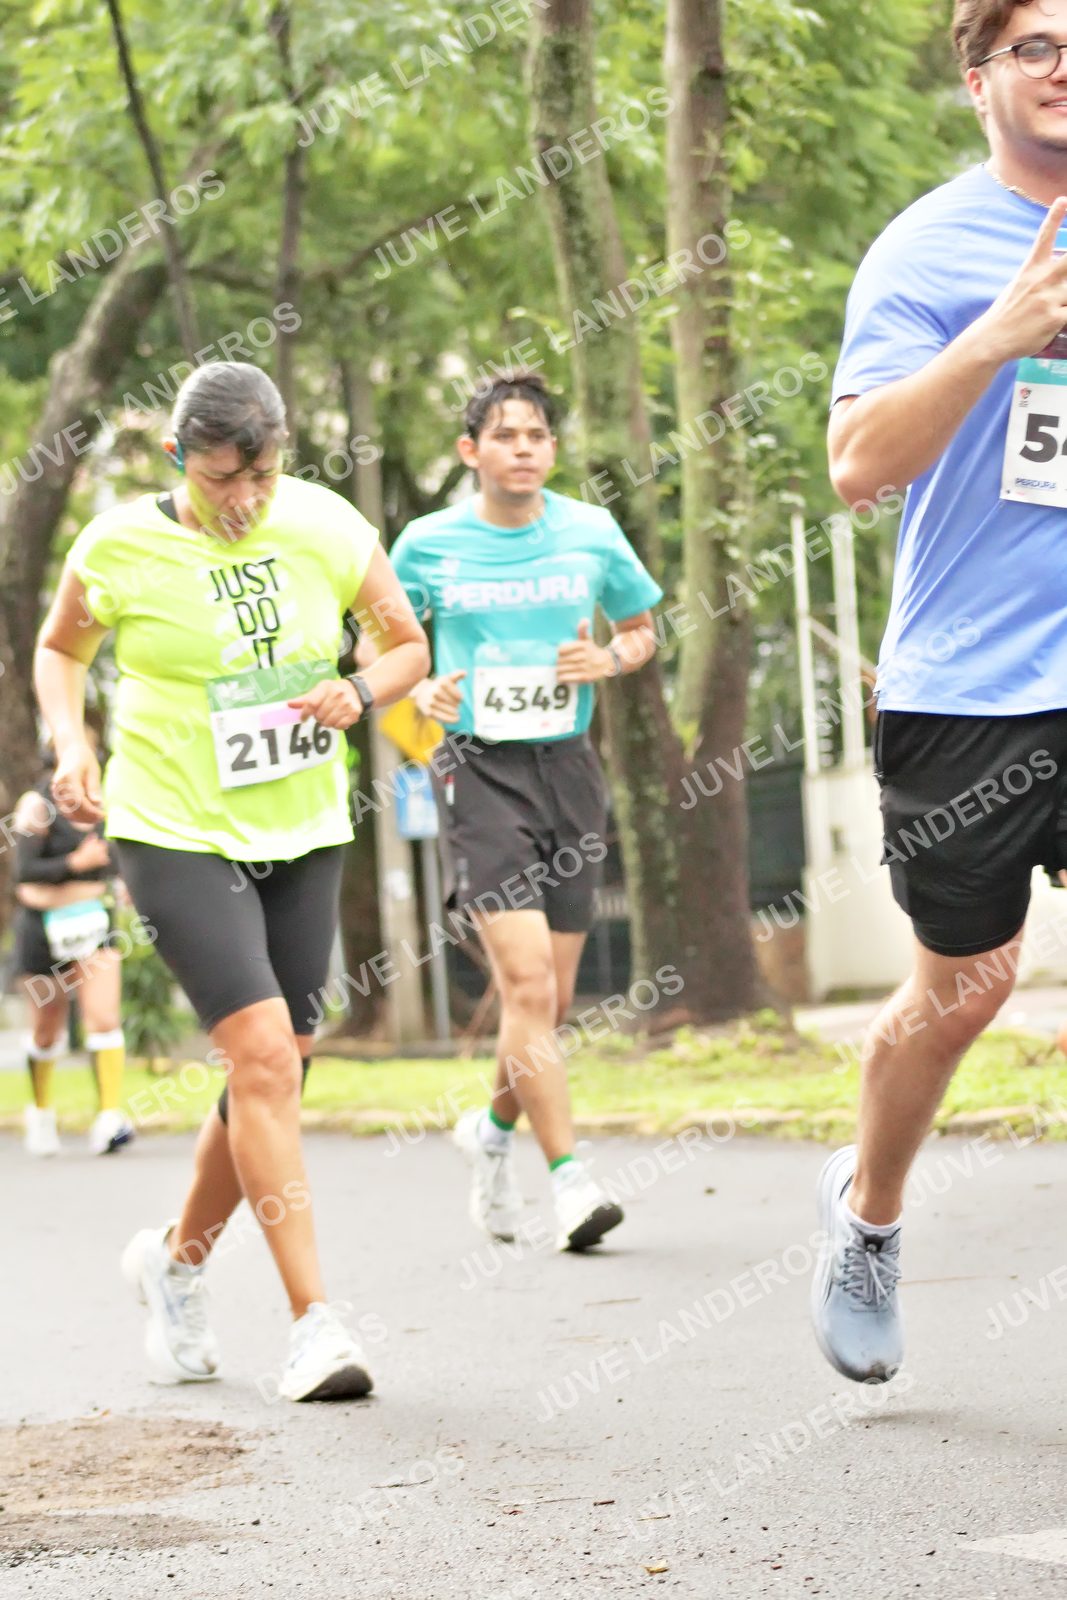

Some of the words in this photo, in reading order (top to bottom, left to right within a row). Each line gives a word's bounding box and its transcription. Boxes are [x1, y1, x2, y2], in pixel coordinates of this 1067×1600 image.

[1019, 413, 1067, 463] 5
[210, 558, 279, 601] JUST
[443, 575, 588, 608] PERDURA
[234, 597, 280, 636] DO
[253, 636, 277, 669] IT
[483, 684, 571, 712] 4349
[227, 722, 332, 772] 2146
